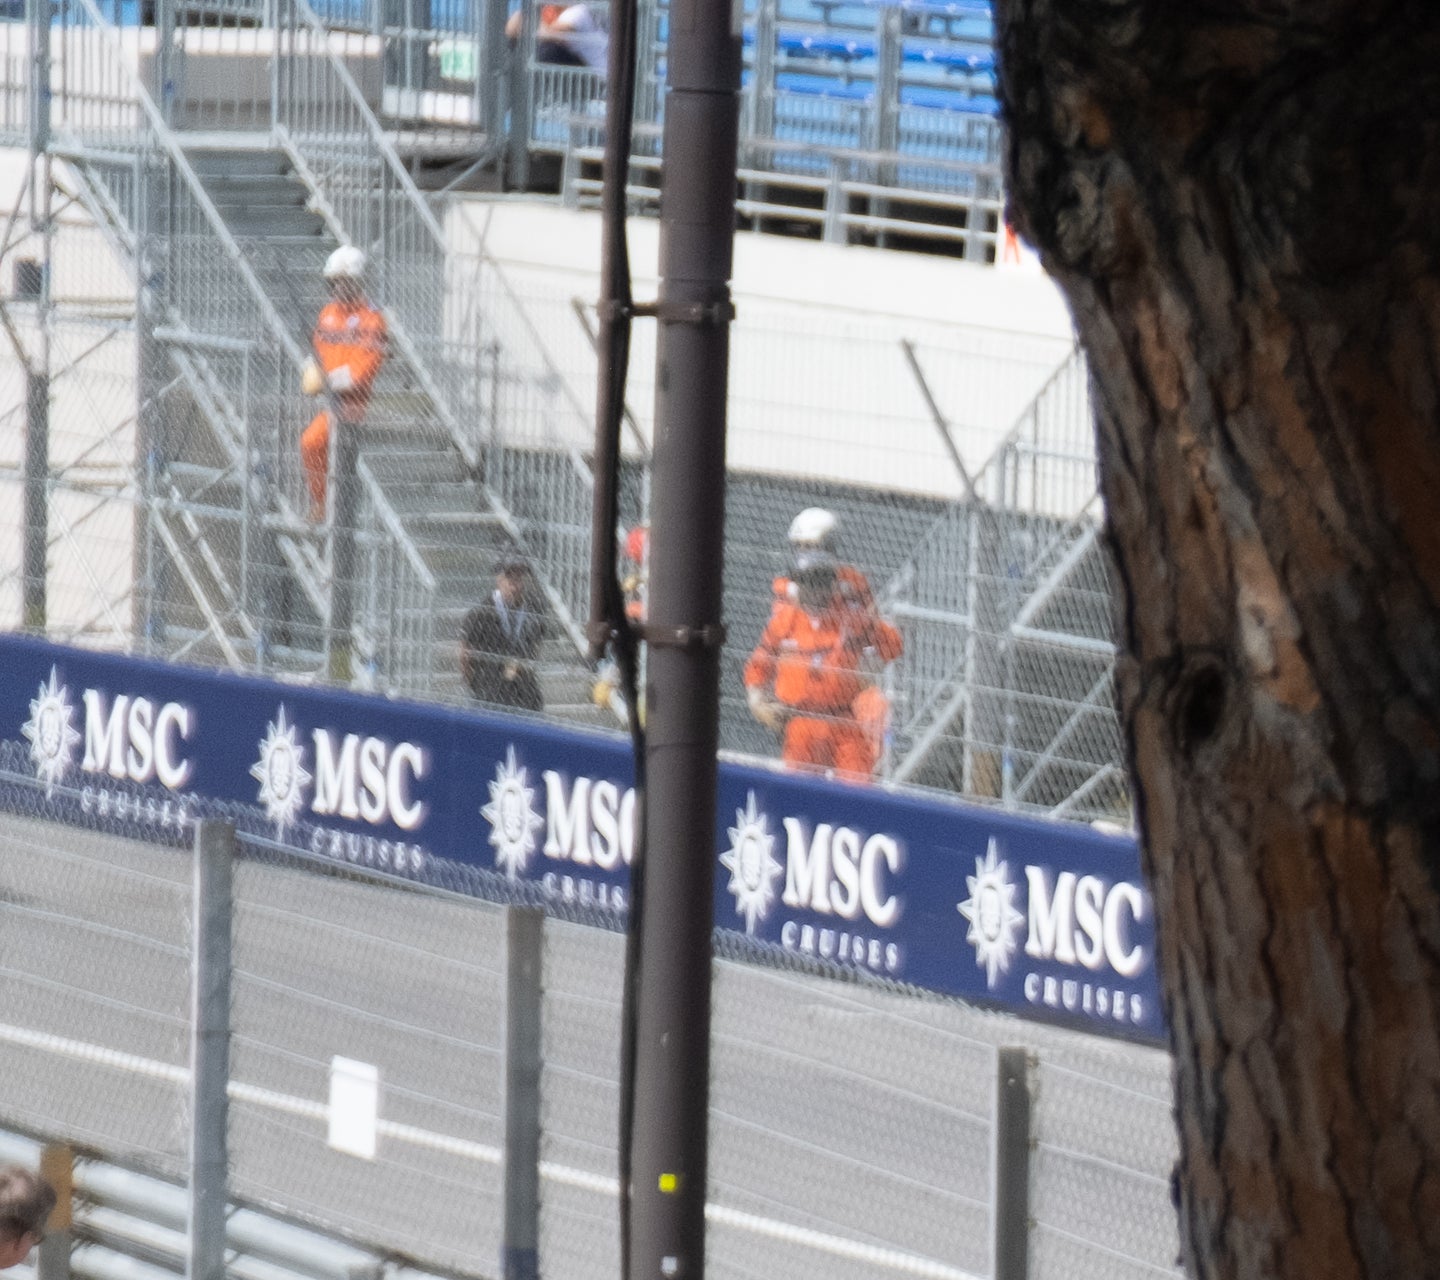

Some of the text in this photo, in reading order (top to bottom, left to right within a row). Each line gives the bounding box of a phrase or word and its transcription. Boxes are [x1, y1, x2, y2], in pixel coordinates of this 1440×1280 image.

[82, 688, 191, 789] MSC
[312, 728, 425, 829] MSC
[311, 826, 425, 870] CRUISES
[781, 816, 900, 927] MSC
[543, 871, 628, 909] CRUIS
[1025, 865, 1144, 977] MSC
[781, 920, 900, 970] CRUISES
[1024, 972, 1144, 1022] CRUISES
